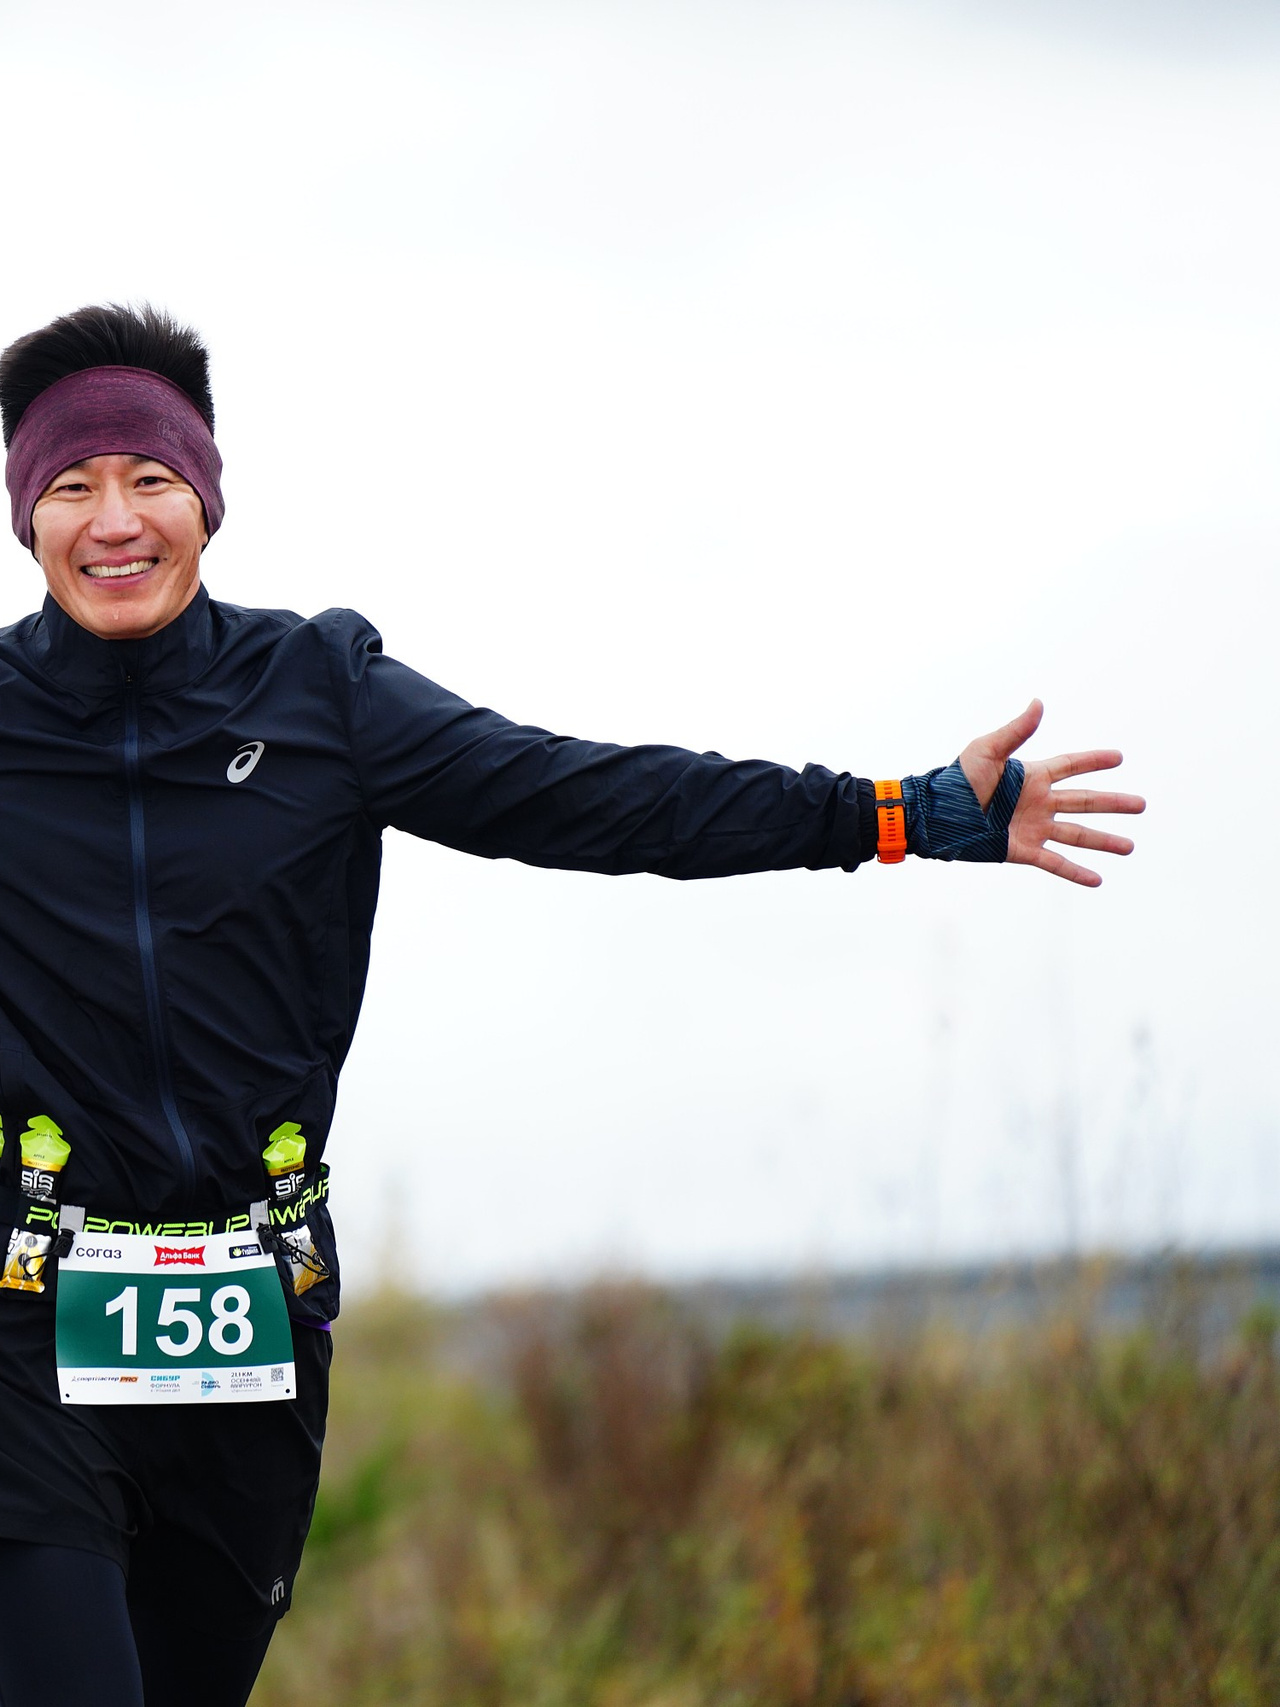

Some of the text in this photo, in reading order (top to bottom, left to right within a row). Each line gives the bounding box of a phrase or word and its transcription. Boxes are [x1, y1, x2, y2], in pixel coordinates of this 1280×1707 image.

[75, 1246, 122, 1259] согаз
[160, 1251, 182, 1261] Альфа
[105, 1284, 254, 1357] 158
